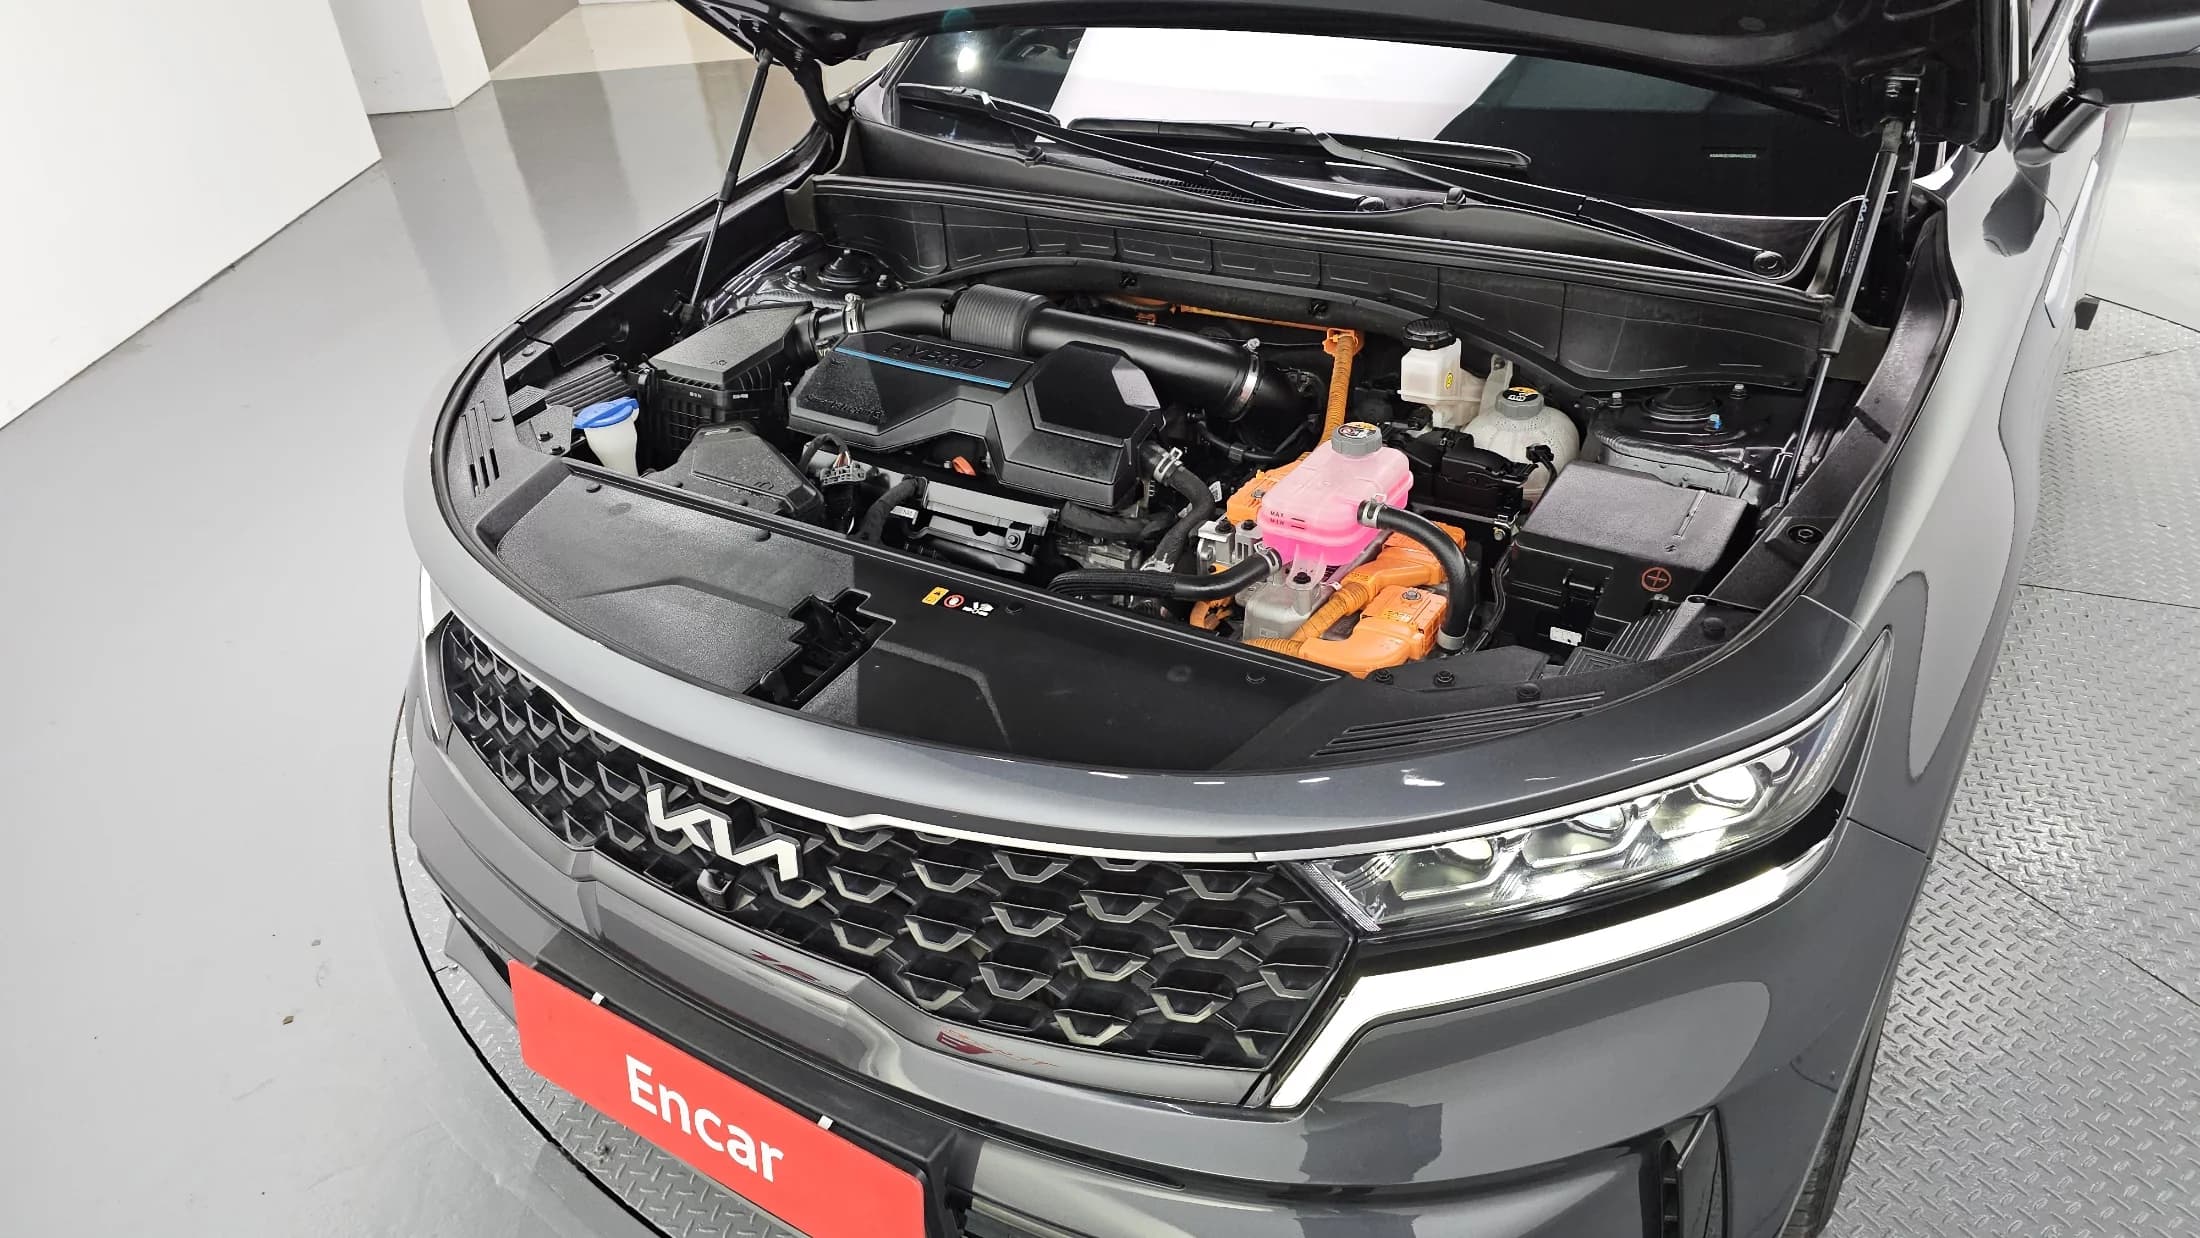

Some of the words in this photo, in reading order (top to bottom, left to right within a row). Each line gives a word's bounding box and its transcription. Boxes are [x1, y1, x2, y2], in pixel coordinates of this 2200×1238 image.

[882, 342, 985, 370] HYBRID
[646, 784, 800, 883] KIA
[625, 1053, 784, 1183] Encar
